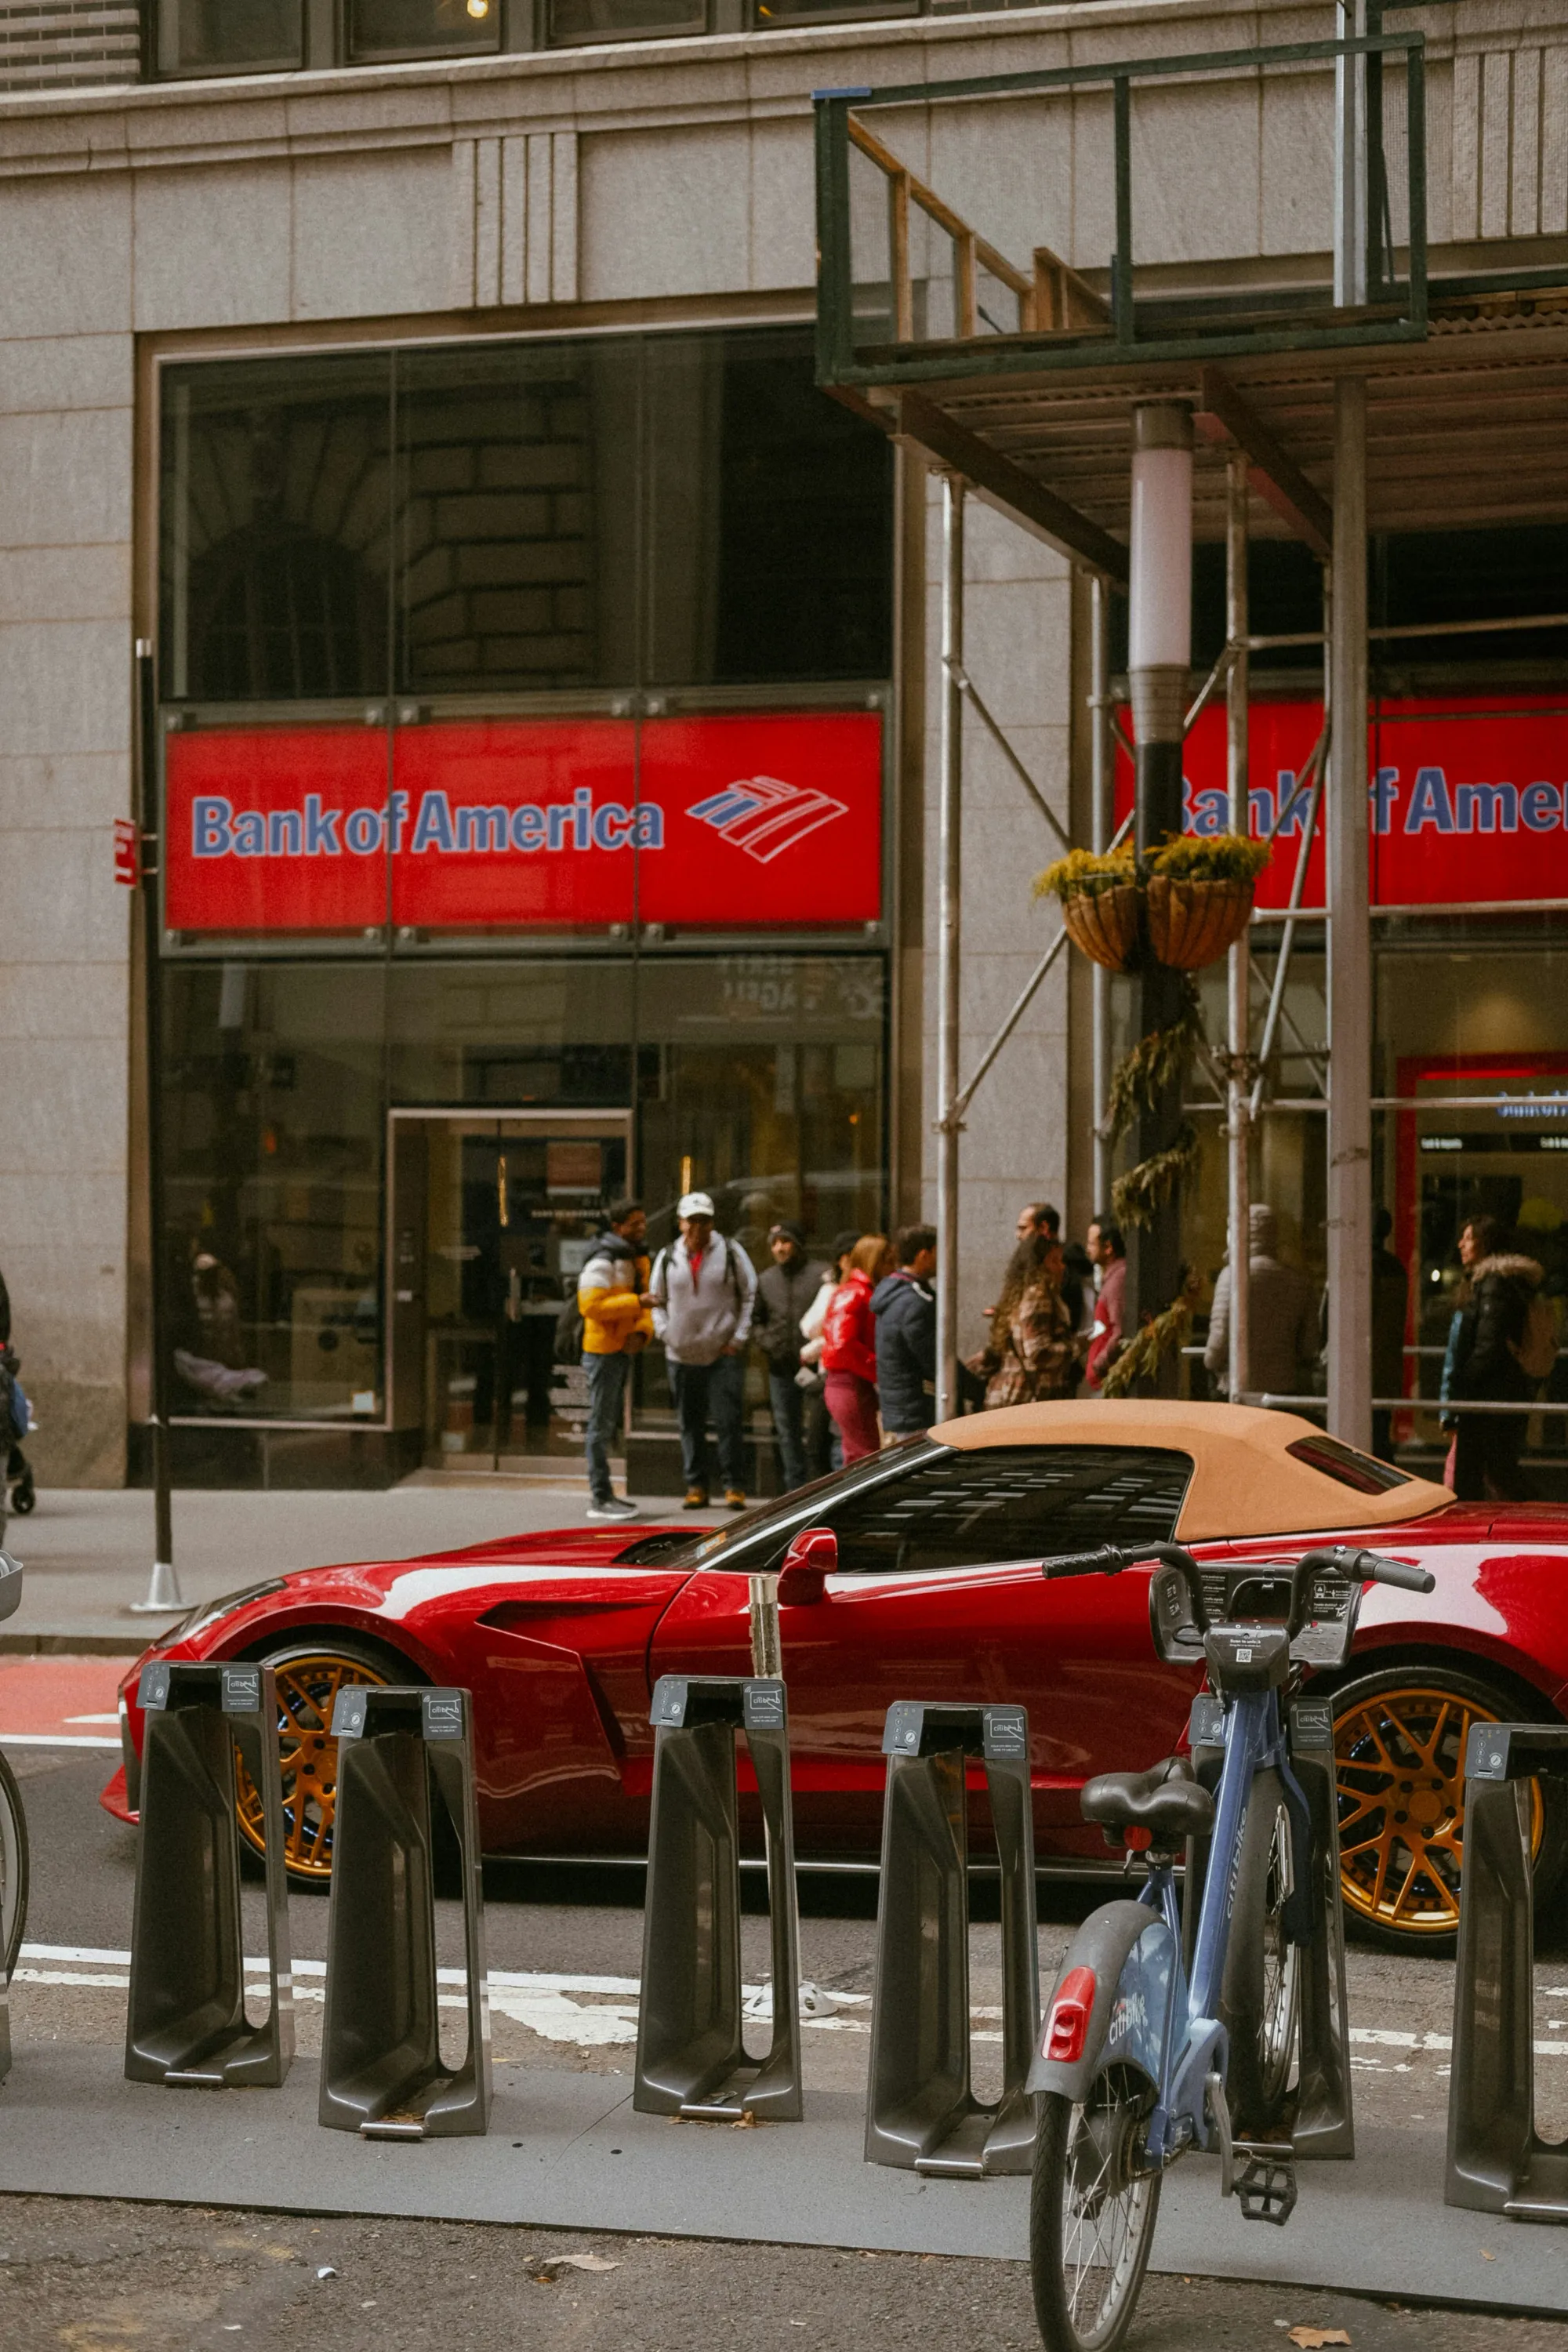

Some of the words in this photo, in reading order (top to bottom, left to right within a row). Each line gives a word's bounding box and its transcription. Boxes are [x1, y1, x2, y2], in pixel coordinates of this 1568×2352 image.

[192, 793, 342, 858] Bank
[345, 790, 408, 855] of
[411, 787, 665, 853] America
[1368, 767, 1399, 835] f
[1403, 766, 1568, 834] Ame
